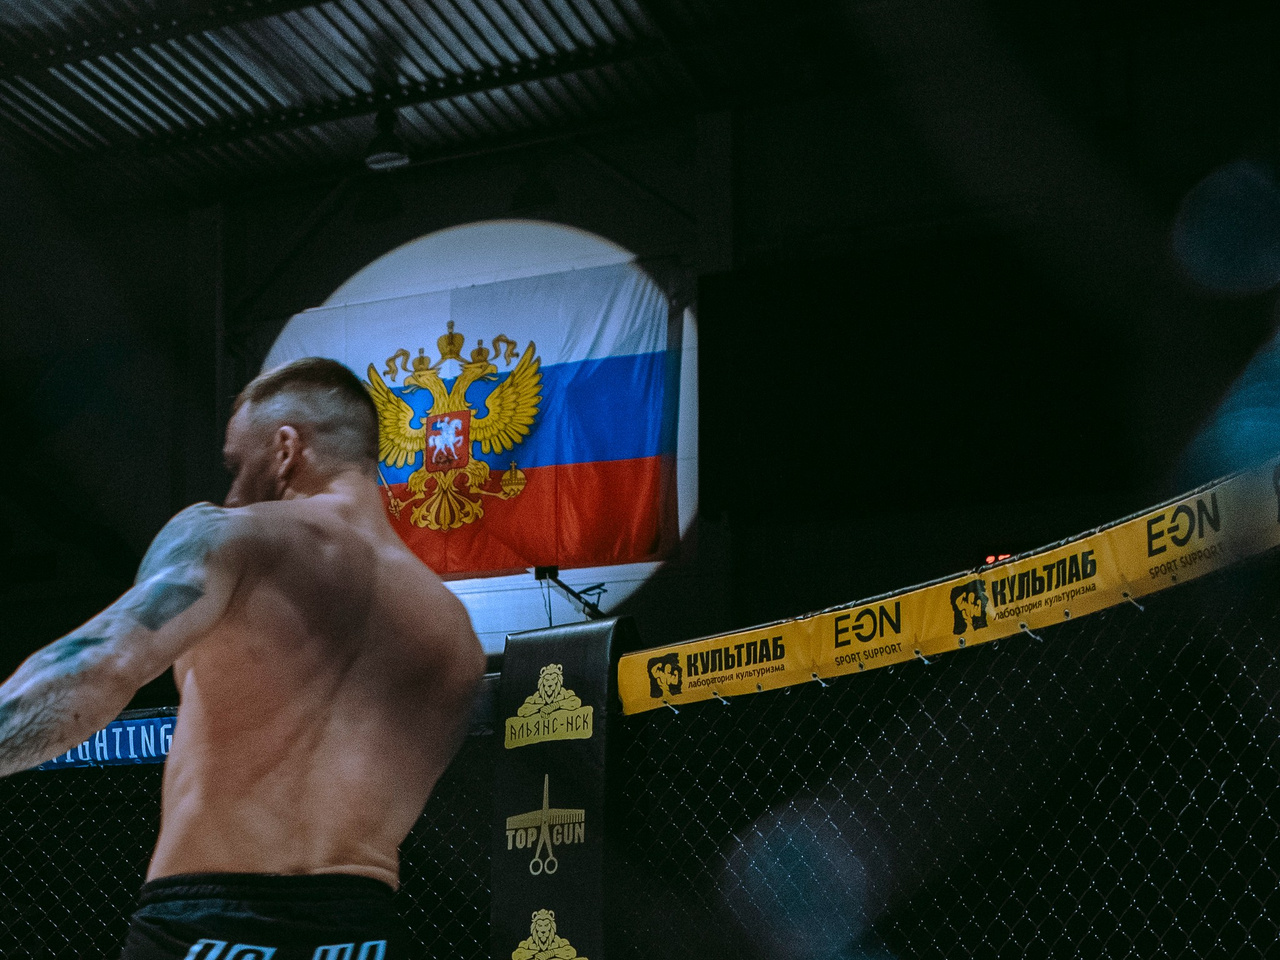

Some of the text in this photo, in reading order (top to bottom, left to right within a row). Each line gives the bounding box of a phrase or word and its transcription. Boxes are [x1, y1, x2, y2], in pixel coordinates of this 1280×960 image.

[991, 550, 1097, 607] КУЛЬТЛАБ
[1149, 559, 1179, 579] SPORT
[1044, 582, 1097, 610] культуризма
[834, 601, 902, 649] EON
[687, 636, 786, 678] КУЛЬТЛАБ
[834, 642, 903, 667] SPORT SUPPORT
[735, 663, 786, 682] культуризма
[509, 713, 590, 742] АЛЬЯНС-НСК
[506, 821, 586, 851] TOP GUN
